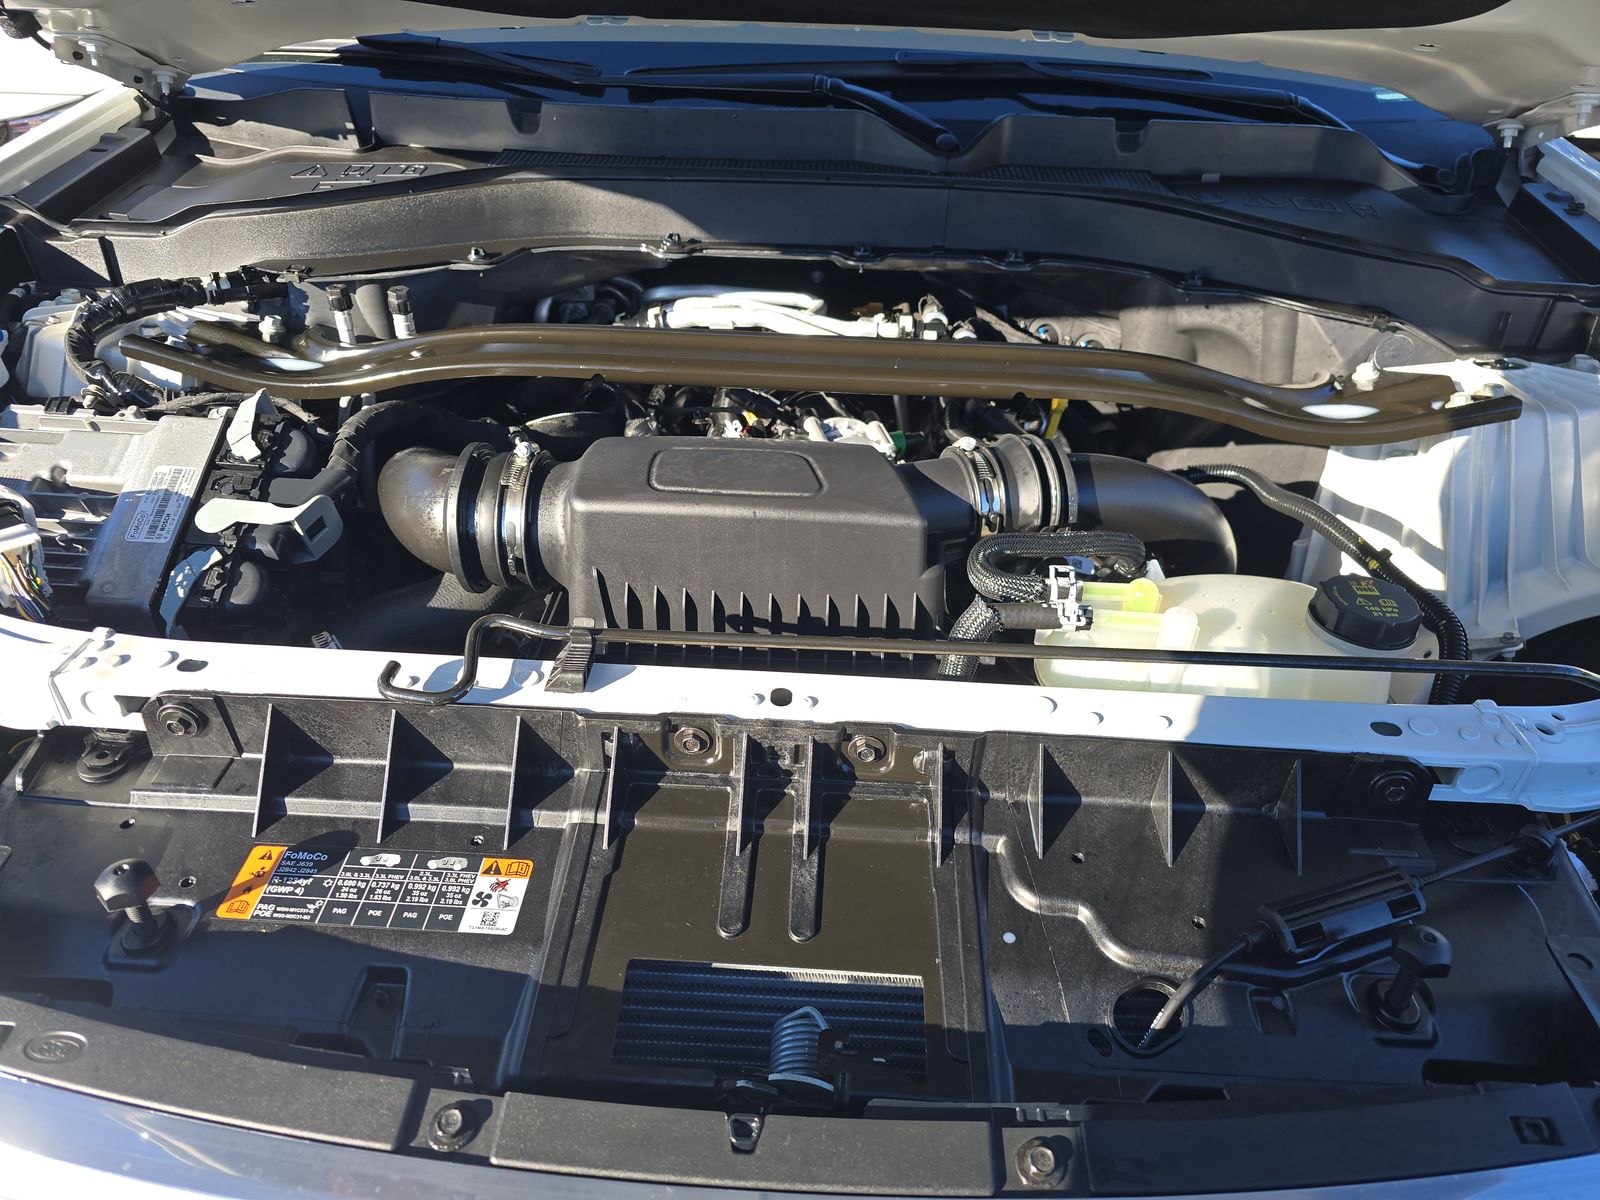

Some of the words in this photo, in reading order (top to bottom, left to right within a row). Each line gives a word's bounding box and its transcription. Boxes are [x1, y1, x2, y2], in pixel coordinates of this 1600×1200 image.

[160, 513, 172, 532] BOSCH
[284, 851, 328, 861] FoMoCo
[272, 876, 314, 886] R-1234yf
[357, 881, 367, 889] kg
[266, 885, 294, 894] (GWP
[390, 882, 401, 891] kg
[427, 884, 437, 892] kg
[461, 886, 471, 894] kg
[257, 903, 276, 911] PAG
[367, 909, 383, 917] POE
[402, 911, 418, 919] PAG
